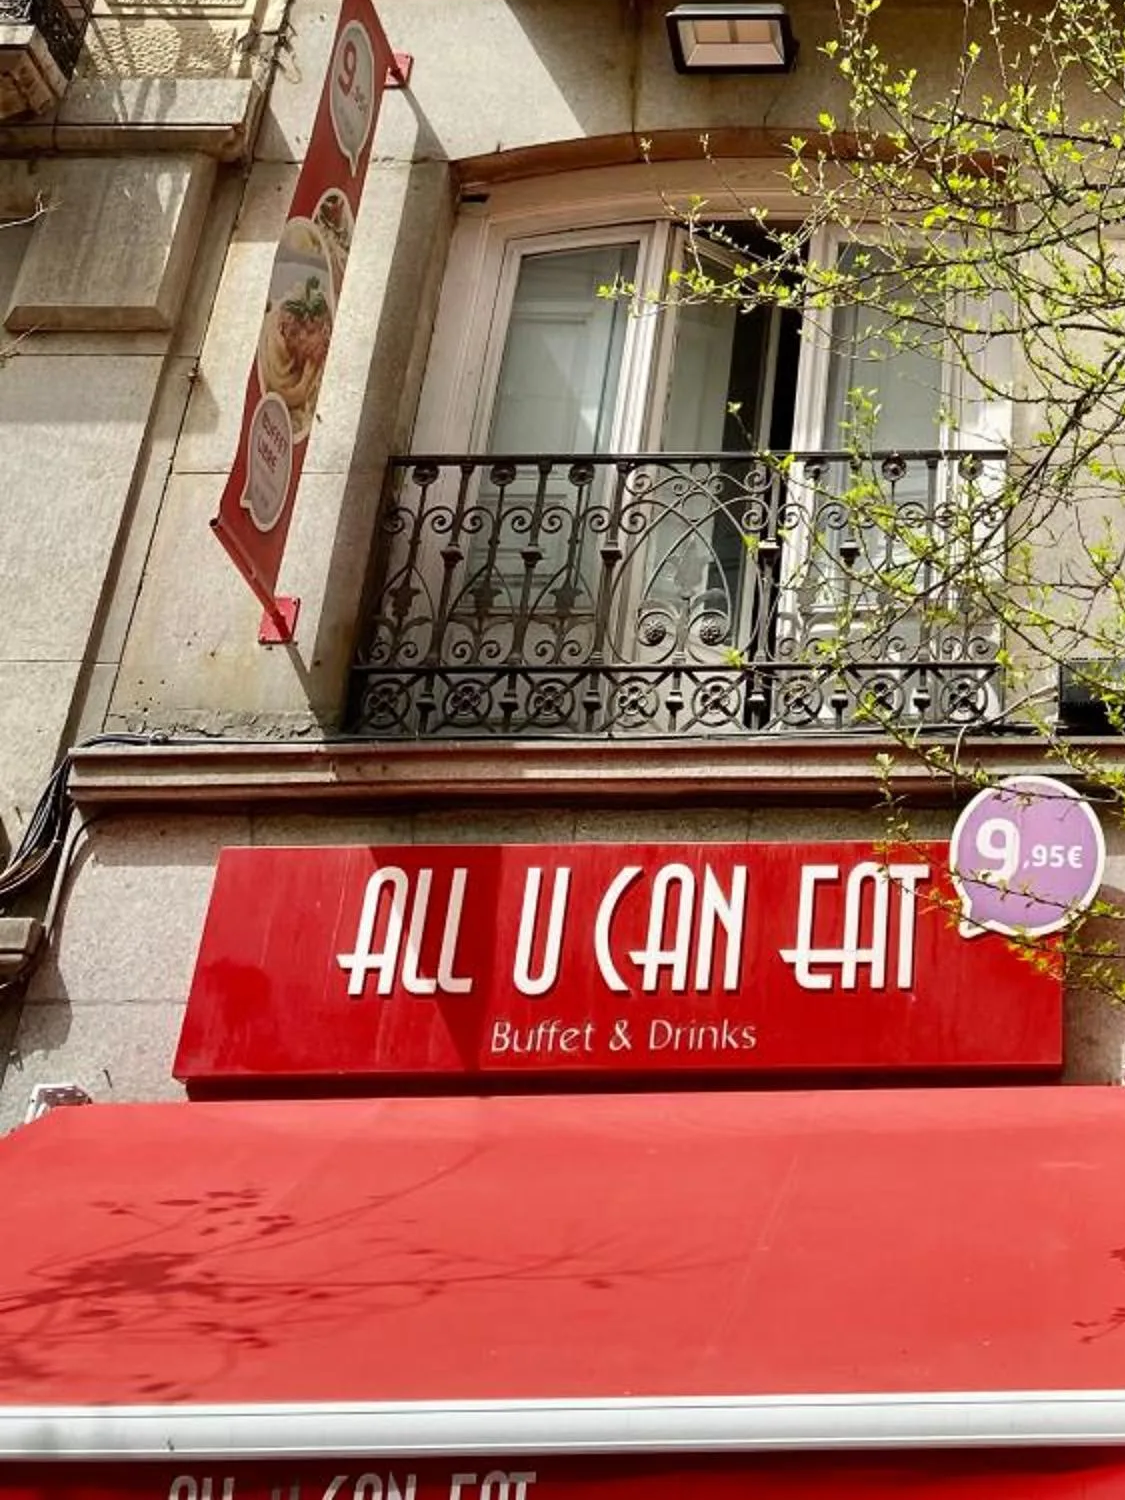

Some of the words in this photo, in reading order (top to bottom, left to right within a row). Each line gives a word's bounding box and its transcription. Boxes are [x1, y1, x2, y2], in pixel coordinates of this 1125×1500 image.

[975, 817, 1084, 885] 9,95€
[336, 864, 472, 996] ALL
[513, 867, 571, 996] U
[594, 863, 749, 992] CAN
[779, 862, 930, 990] EAT
[490, 1018, 594, 1052] Buffet
[609, 1019, 631, 1051] &
[648, 1018, 758, 1052] Drinks
